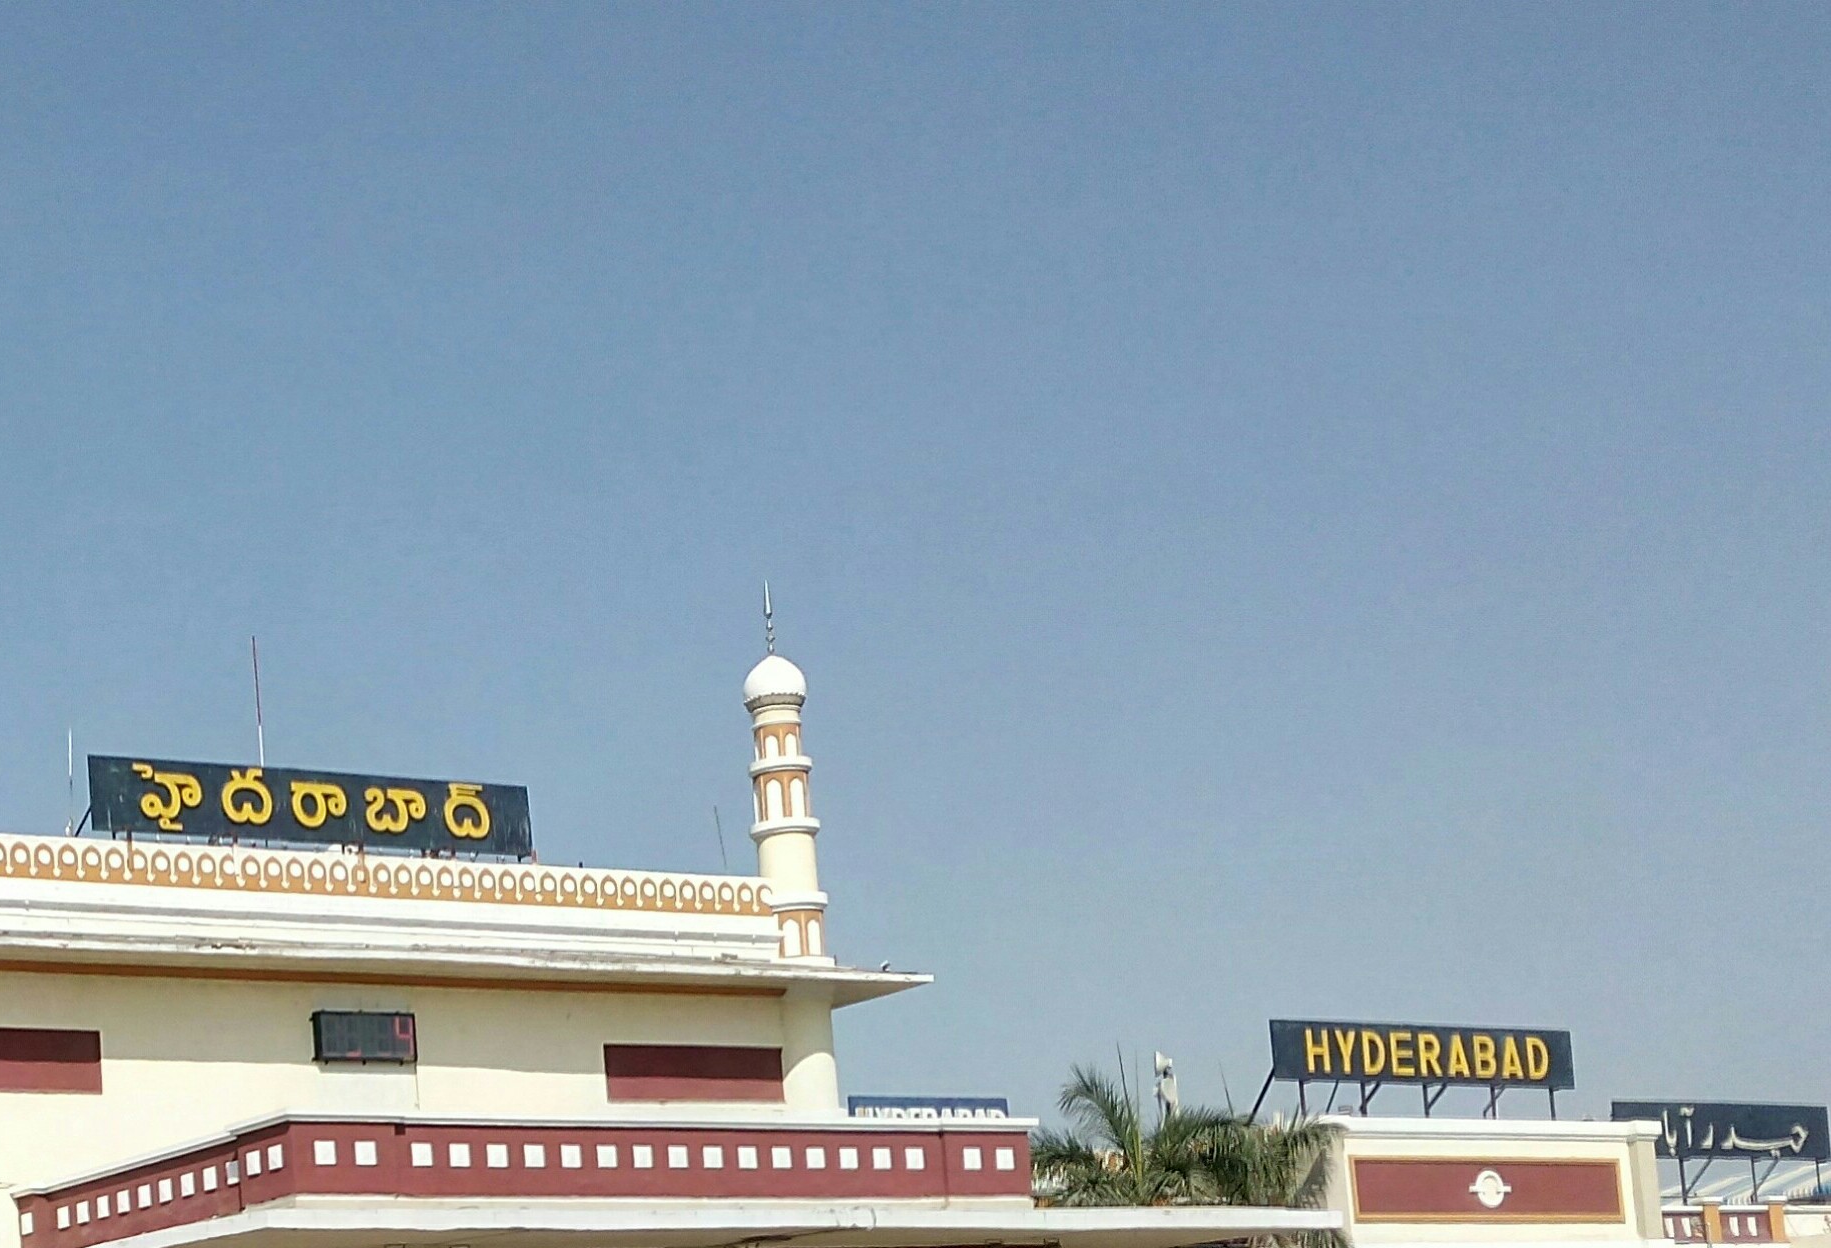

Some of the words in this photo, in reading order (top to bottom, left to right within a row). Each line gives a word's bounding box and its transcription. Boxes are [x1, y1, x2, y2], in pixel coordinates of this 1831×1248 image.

[131, 762, 491, 840] హైదరాబాద్
[1304, 1027, 1550, 1081] HYDERABAD
[1662, 1104, 1809, 1157] حیدرآبا
